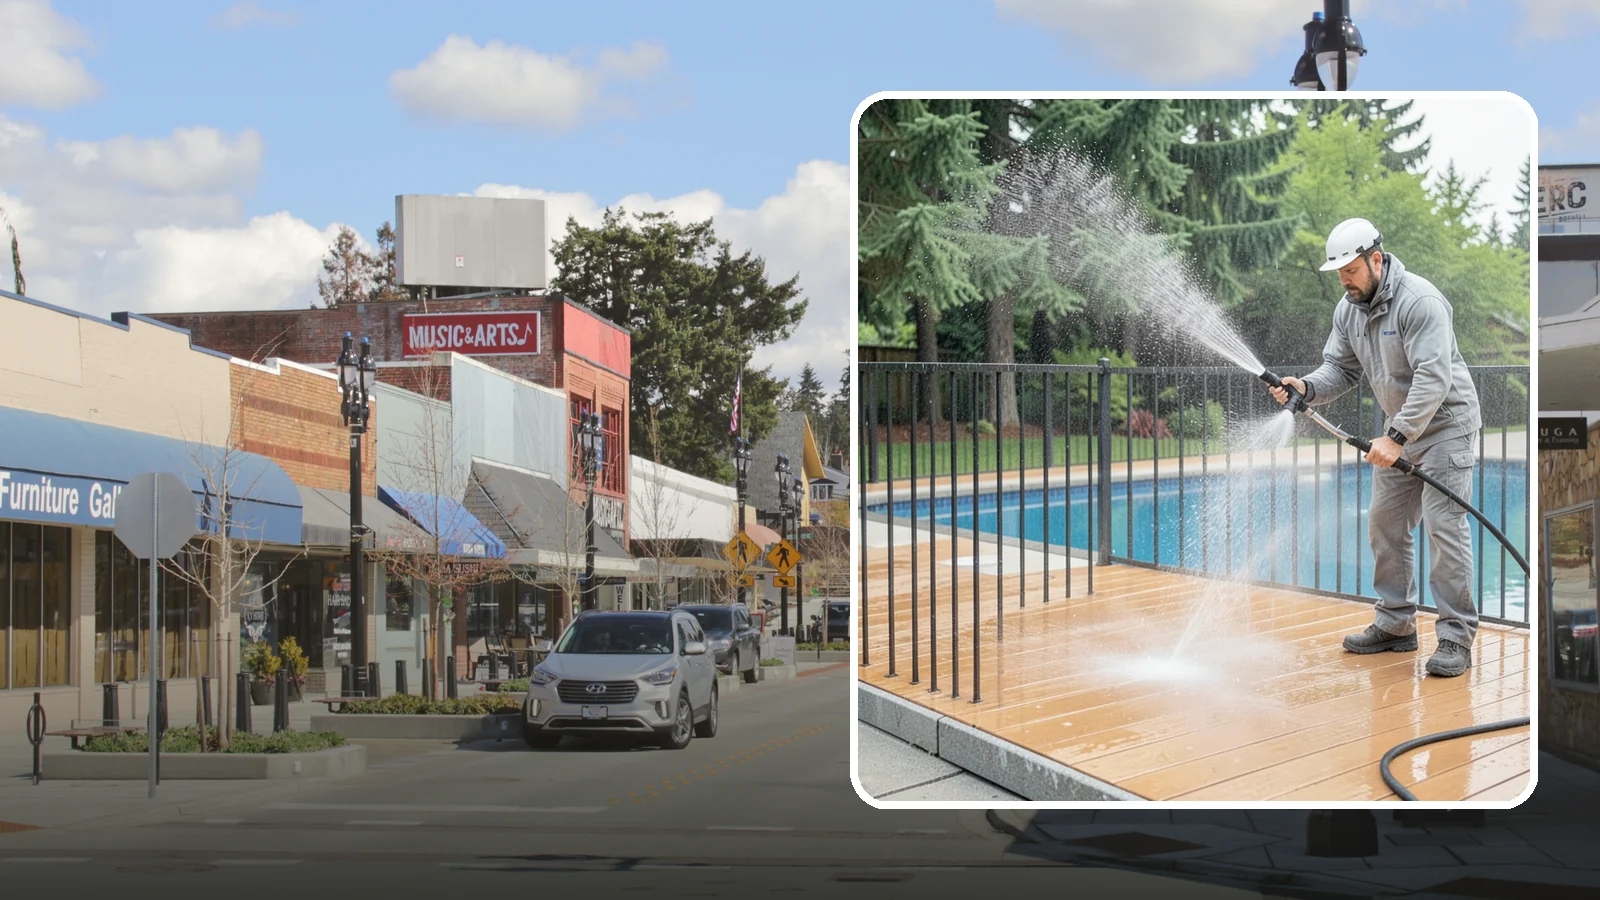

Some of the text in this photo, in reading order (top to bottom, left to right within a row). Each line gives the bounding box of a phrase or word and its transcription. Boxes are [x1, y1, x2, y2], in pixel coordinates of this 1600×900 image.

[0, 471, 122, 519] Furniture Gal
[453, 563, 478, 574] SUSHI
